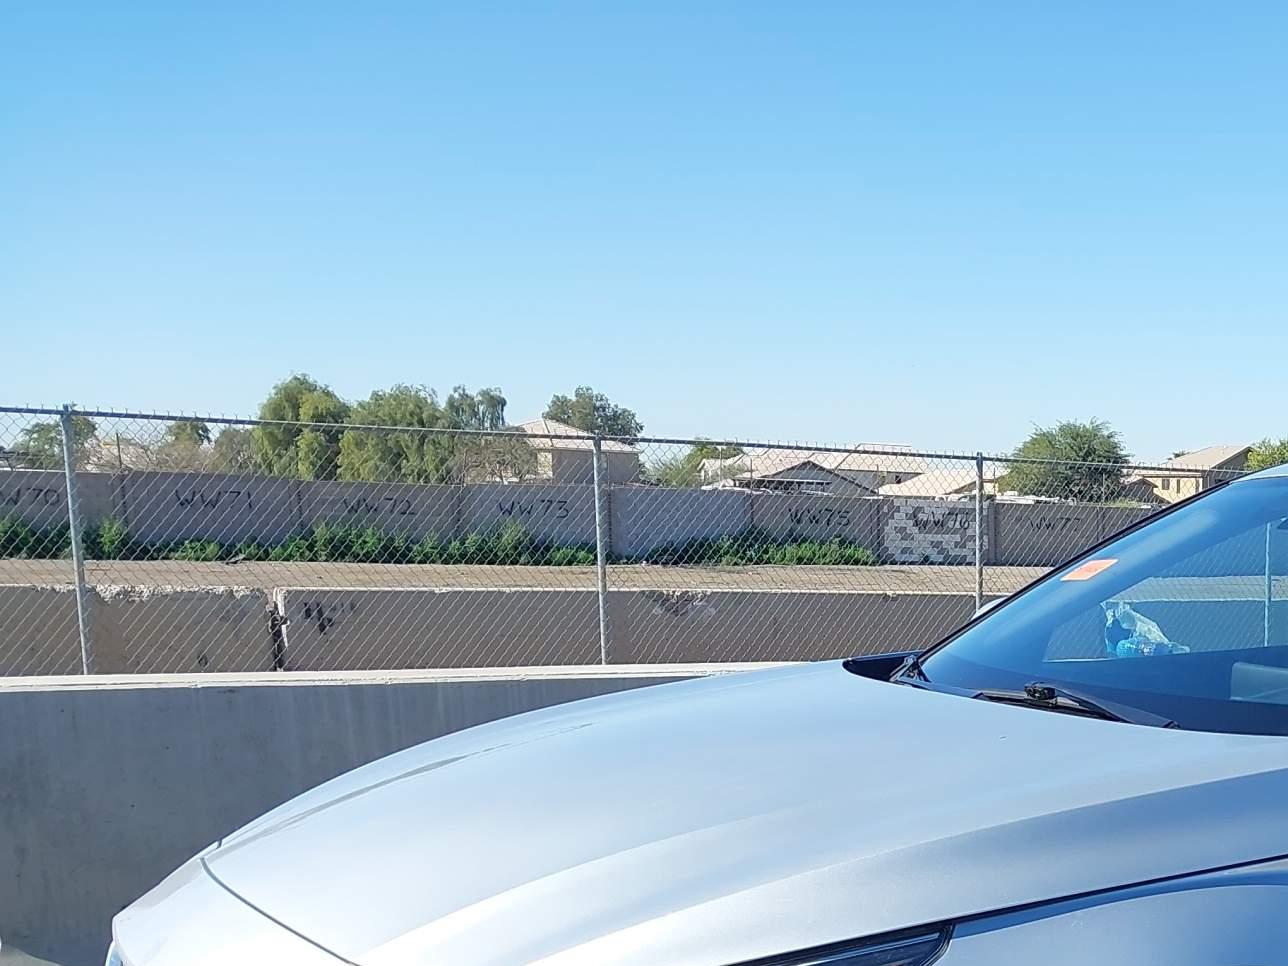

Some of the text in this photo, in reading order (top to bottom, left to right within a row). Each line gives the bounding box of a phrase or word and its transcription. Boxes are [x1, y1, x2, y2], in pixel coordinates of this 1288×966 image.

[174, 489, 252, 509] WW71
[342, 498, 416, 515] WW72
[497, 499, 570, 519] WW73
[788, 508, 850, 526] WW75
[912, 510, 971, 530] WW76
